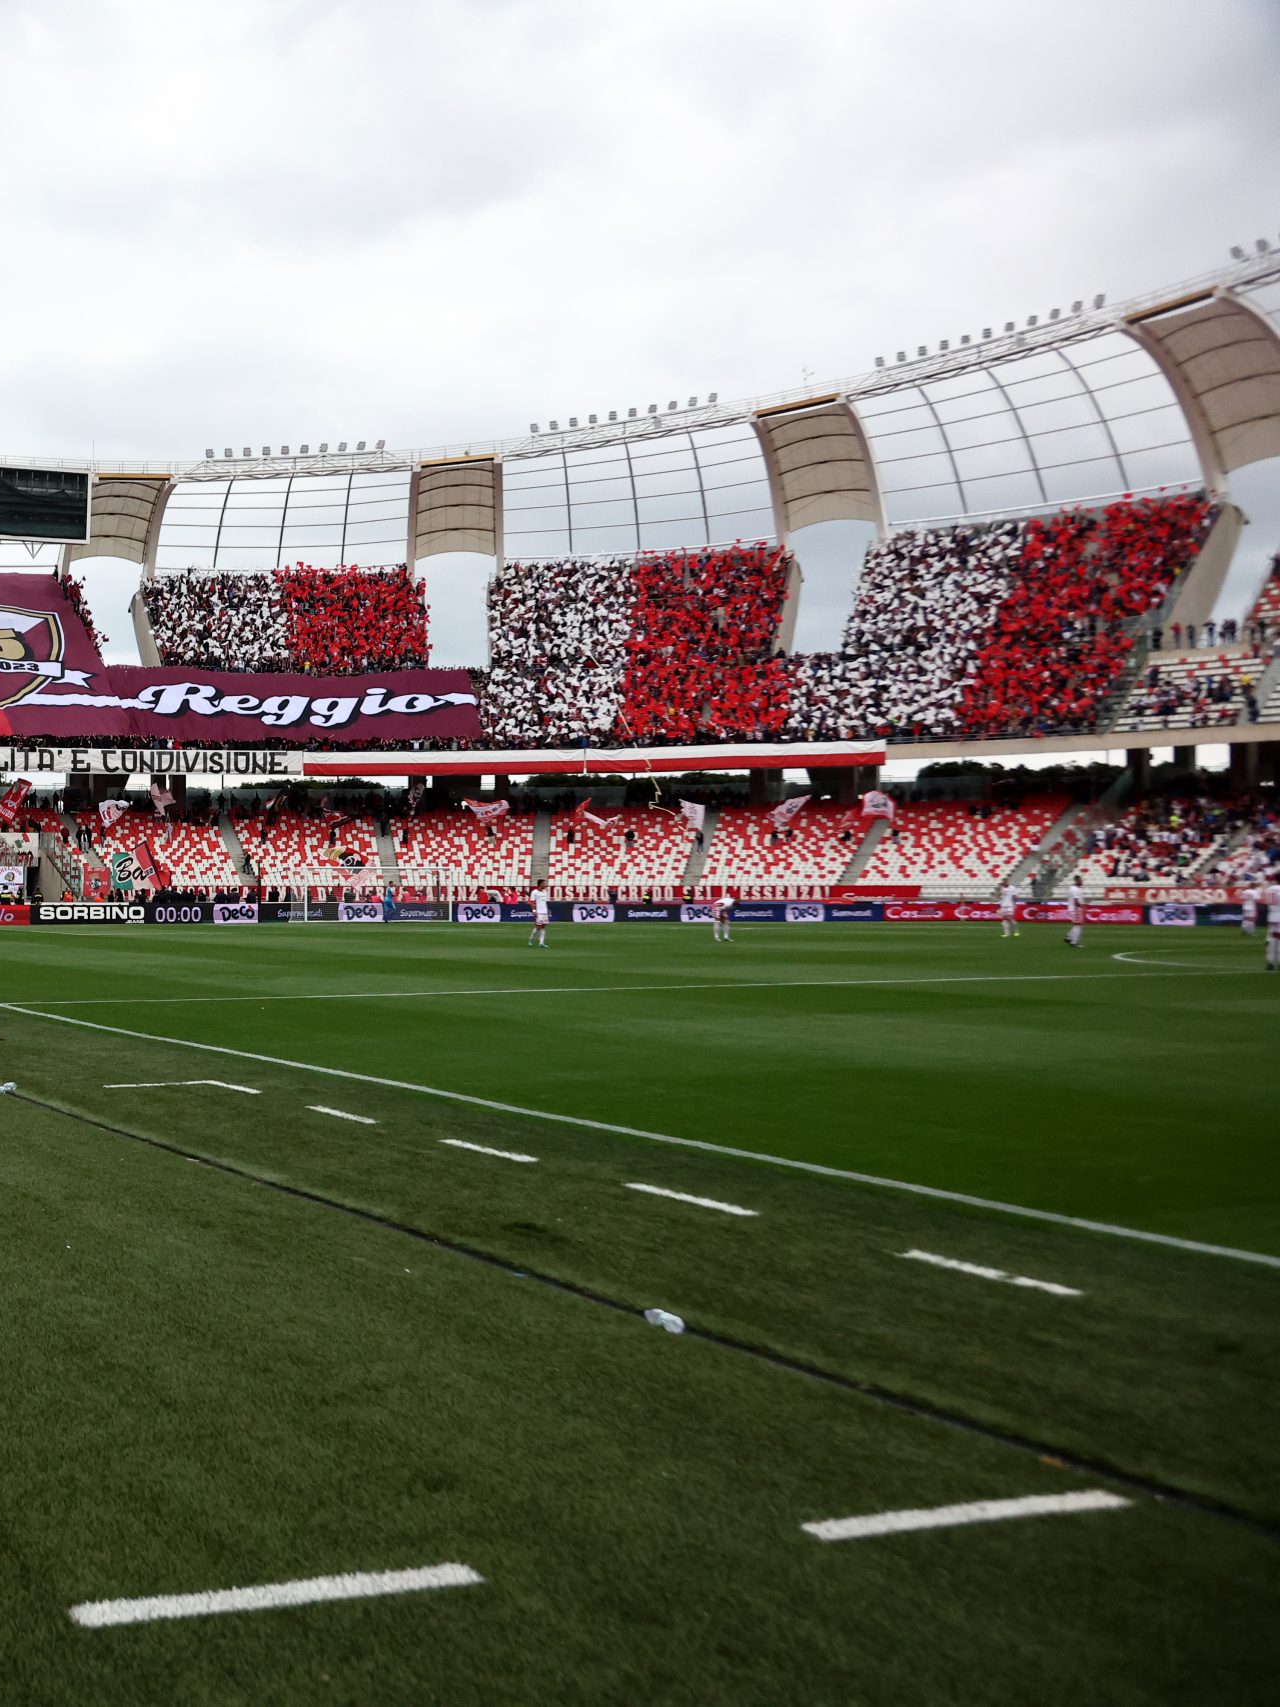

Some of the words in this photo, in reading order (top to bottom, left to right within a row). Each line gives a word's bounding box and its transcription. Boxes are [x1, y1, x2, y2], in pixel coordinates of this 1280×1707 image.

[137, 682, 447, 727] Reggio
[71, 749, 91, 773] E
[101, 750, 288, 774] CONDIVISIONE
[39, 906, 145, 920] SORBINO
[155, 906, 202, 923] 00:00
[220, 904, 255, 922] Decò
[886, 906, 943, 918] Caso
